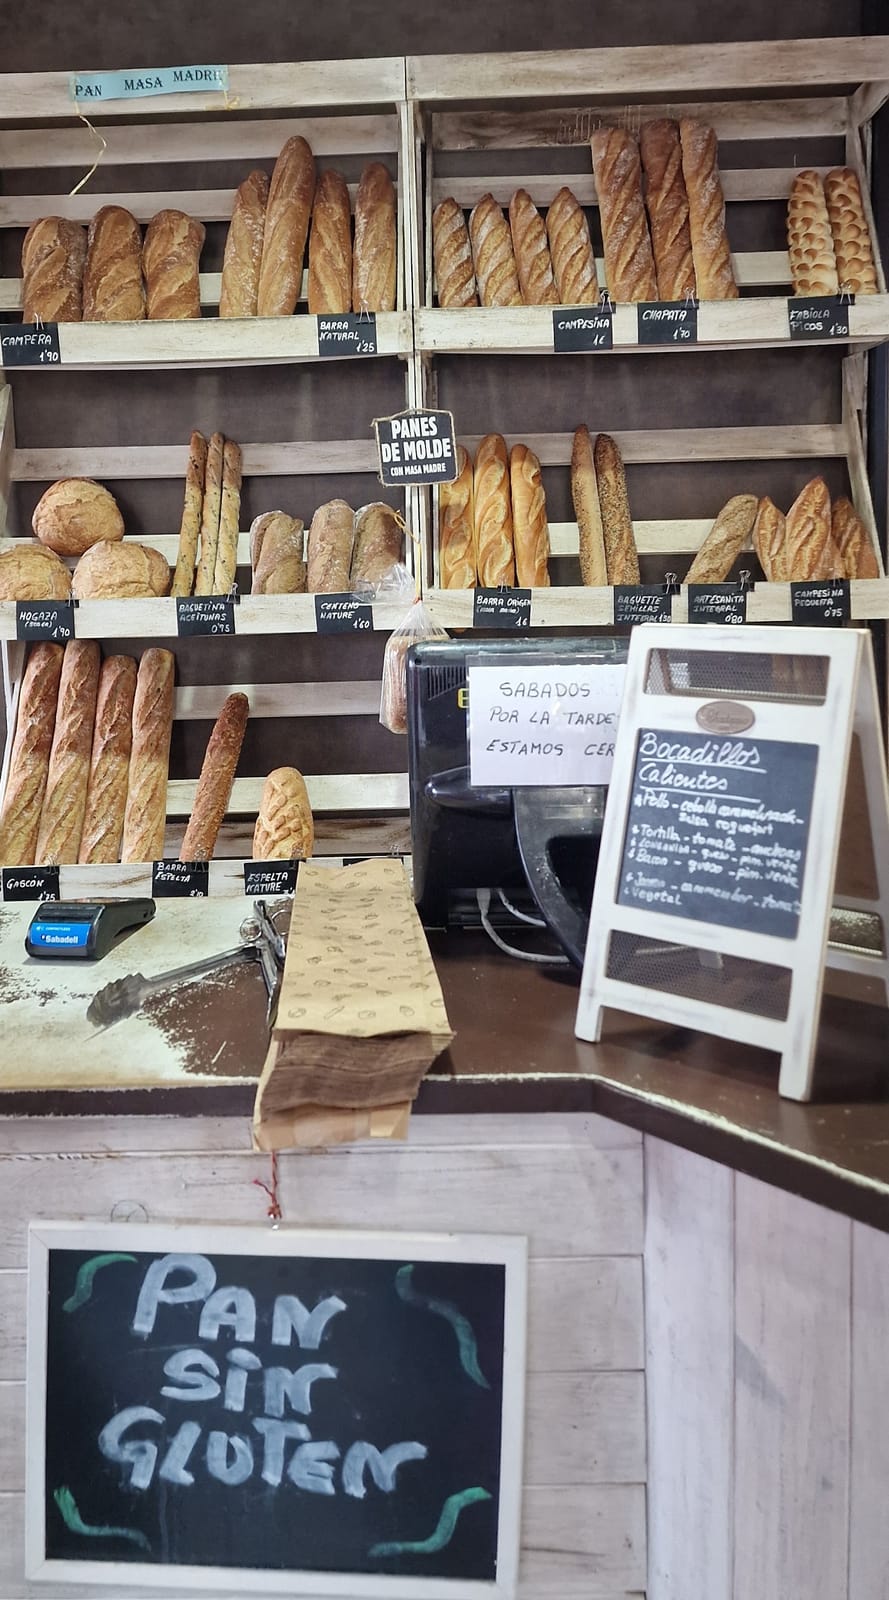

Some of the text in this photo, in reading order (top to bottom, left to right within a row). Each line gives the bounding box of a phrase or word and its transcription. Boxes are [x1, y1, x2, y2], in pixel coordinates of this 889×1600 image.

[75, 84, 102, 97] PAN
[124, 77, 163, 91] MASA
[642, 309, 687, 321] CHAPATA
[320, 321, 349, 330] BARRA
[2, 333, 52, 346] CAMPERA
[319, 331, 360, 341] NATURAL
[673, 326, 690, 340] 1'70
[356, 339, 375, 353] 1'25
[40, 349, 59, 362] 1'90
[391, 416, 438, 439] PANES
[381, 438, 452, 463] DE MOLDE
[390, 462, 447, 477] CON MASA MADRE
[320, 601, 359, 611] CENTENO
[476, 595, 504, 606] BARRA
[617, 595, 664, 605] BAGUETTE
[320, 611, 356, 620] NATURE
[692, 604, 738, 614] INTEGRAL
[823, 607, 843, 618] 0'75
[19, 611, 58, 622] HOGAZA
[352, 617, 370, 629] 1'60
[51, 625, 71, 638] 1'90
[211, 622, 230, 634] 0'75
[499, 681, 591, 698] SABADOS
[489, 705, 616, 725] POR LA TARDE
[486, 738, 616, 757] ESTAMOS CER
[640, 732, 761, 766] Bocadillos
[639, 762, 728, 791] Calientes
[643, 789, 670, 808] Pollo
[641, 824, 681, 842] Tortilla
[157, 861, 187, 873] BARRA
[154, 871, 191, 883] ESPELTA
[247, 871, 289, 882] ESPELTA
[246, 881, 282, 893] NATURE
[45, 934, 79, 944] Sabadell
[131, 1252, 347, 1350] PAN
[98, 1405, 428, 1499] GLUTEN
